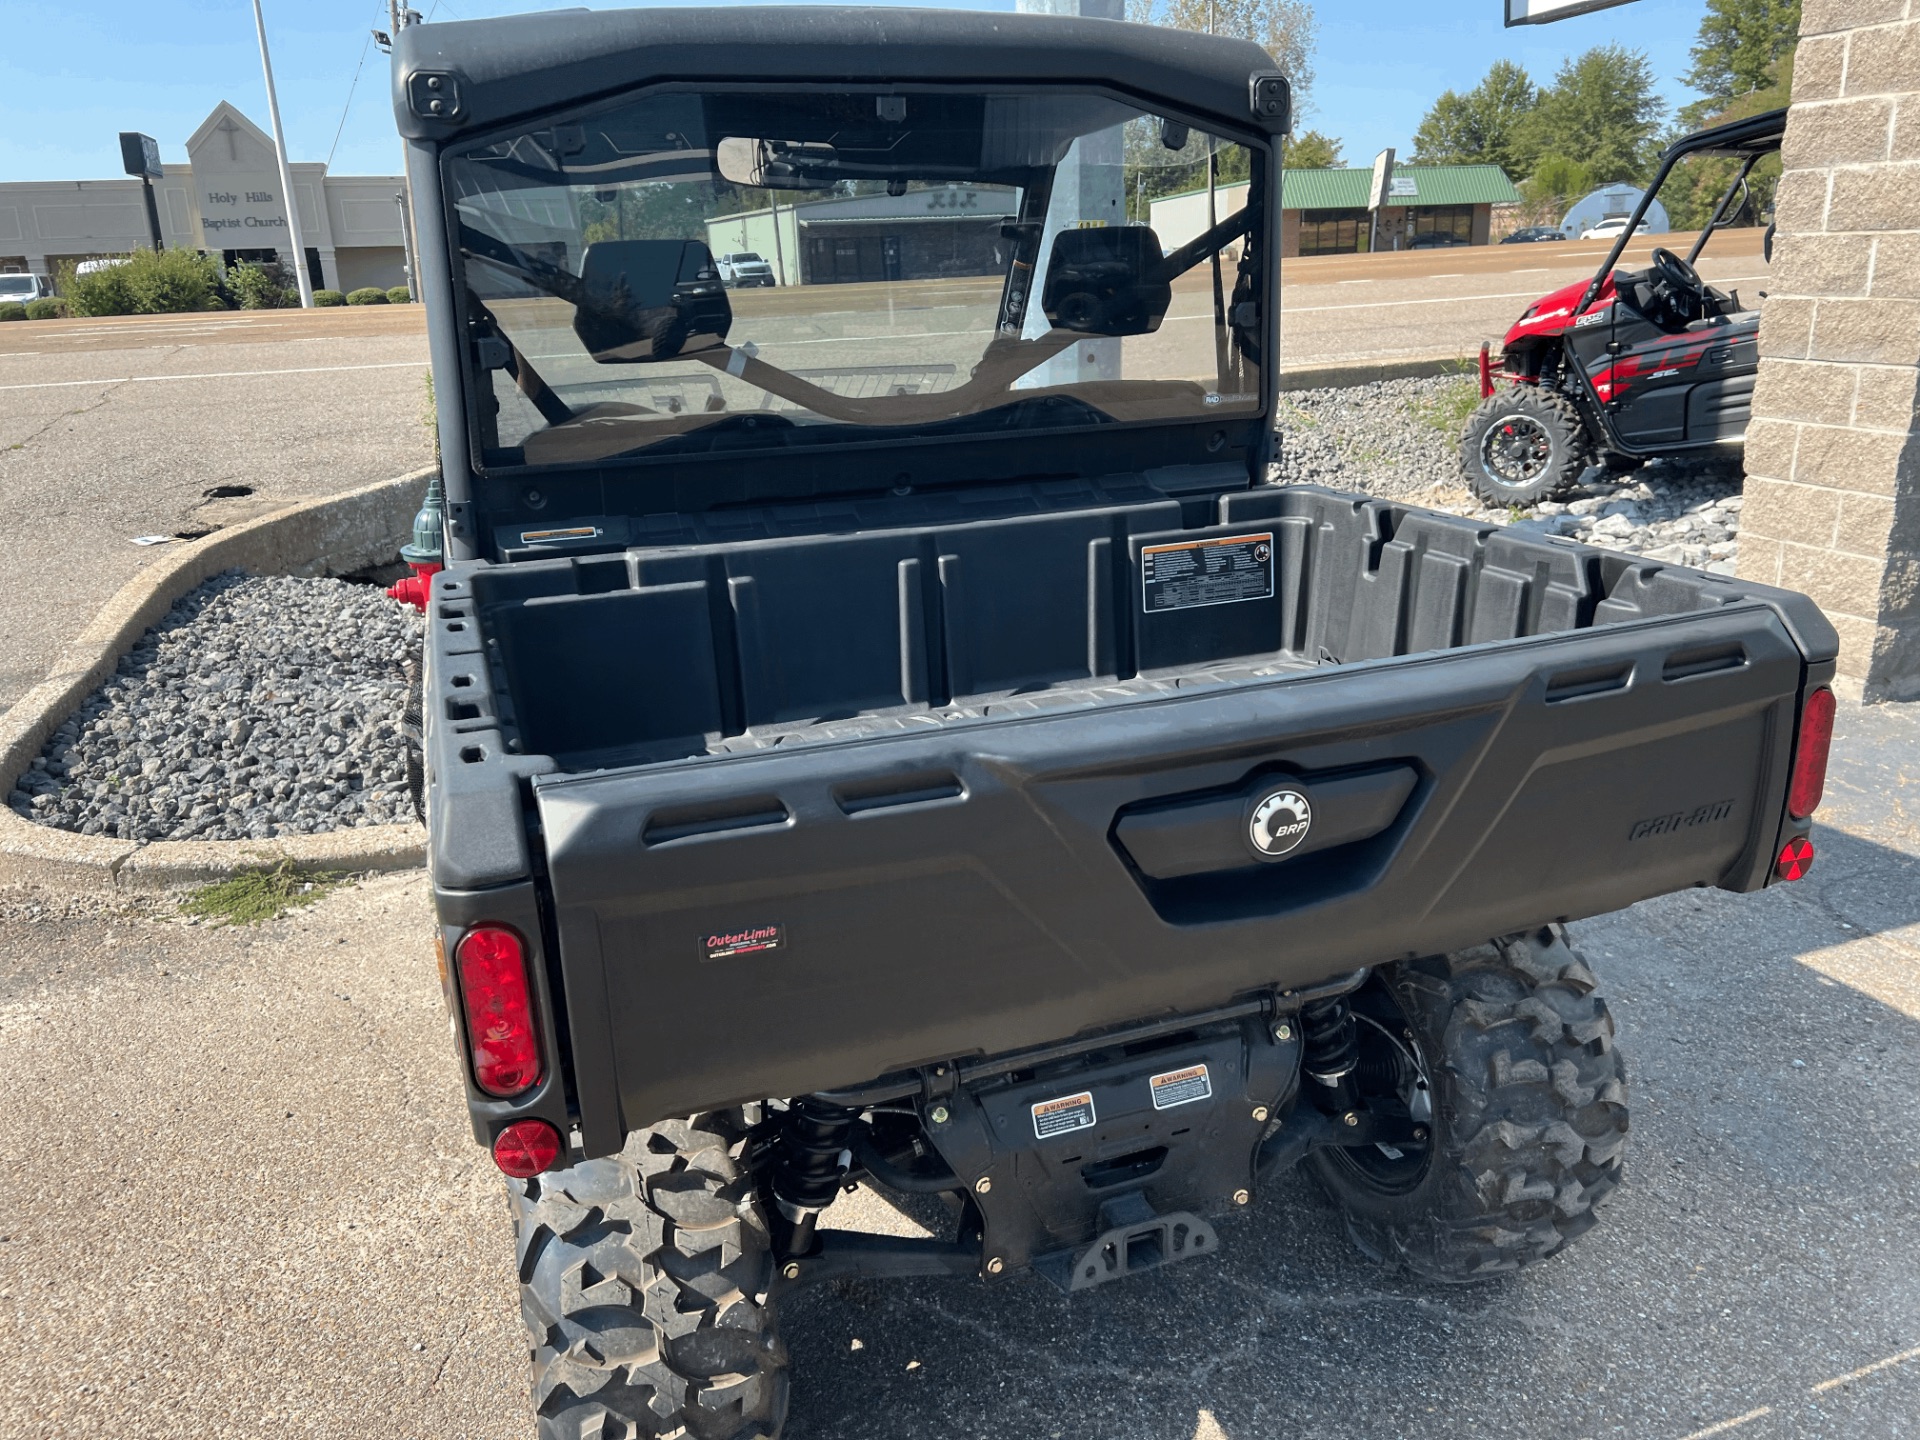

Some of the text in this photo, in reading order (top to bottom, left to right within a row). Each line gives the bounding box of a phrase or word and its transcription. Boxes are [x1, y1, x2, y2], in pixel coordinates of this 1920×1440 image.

[208, 191, 273, 206] Holy Hills
[201, 216, 287, 232] Baptist Church
[1276, 822, 1307, 837] BRP
[706, 926, 777, 948] OuterLimit
[1167, 1070, 1198, 1083] WARNING
[1049, 1098, 1082, 1111] WARNING
